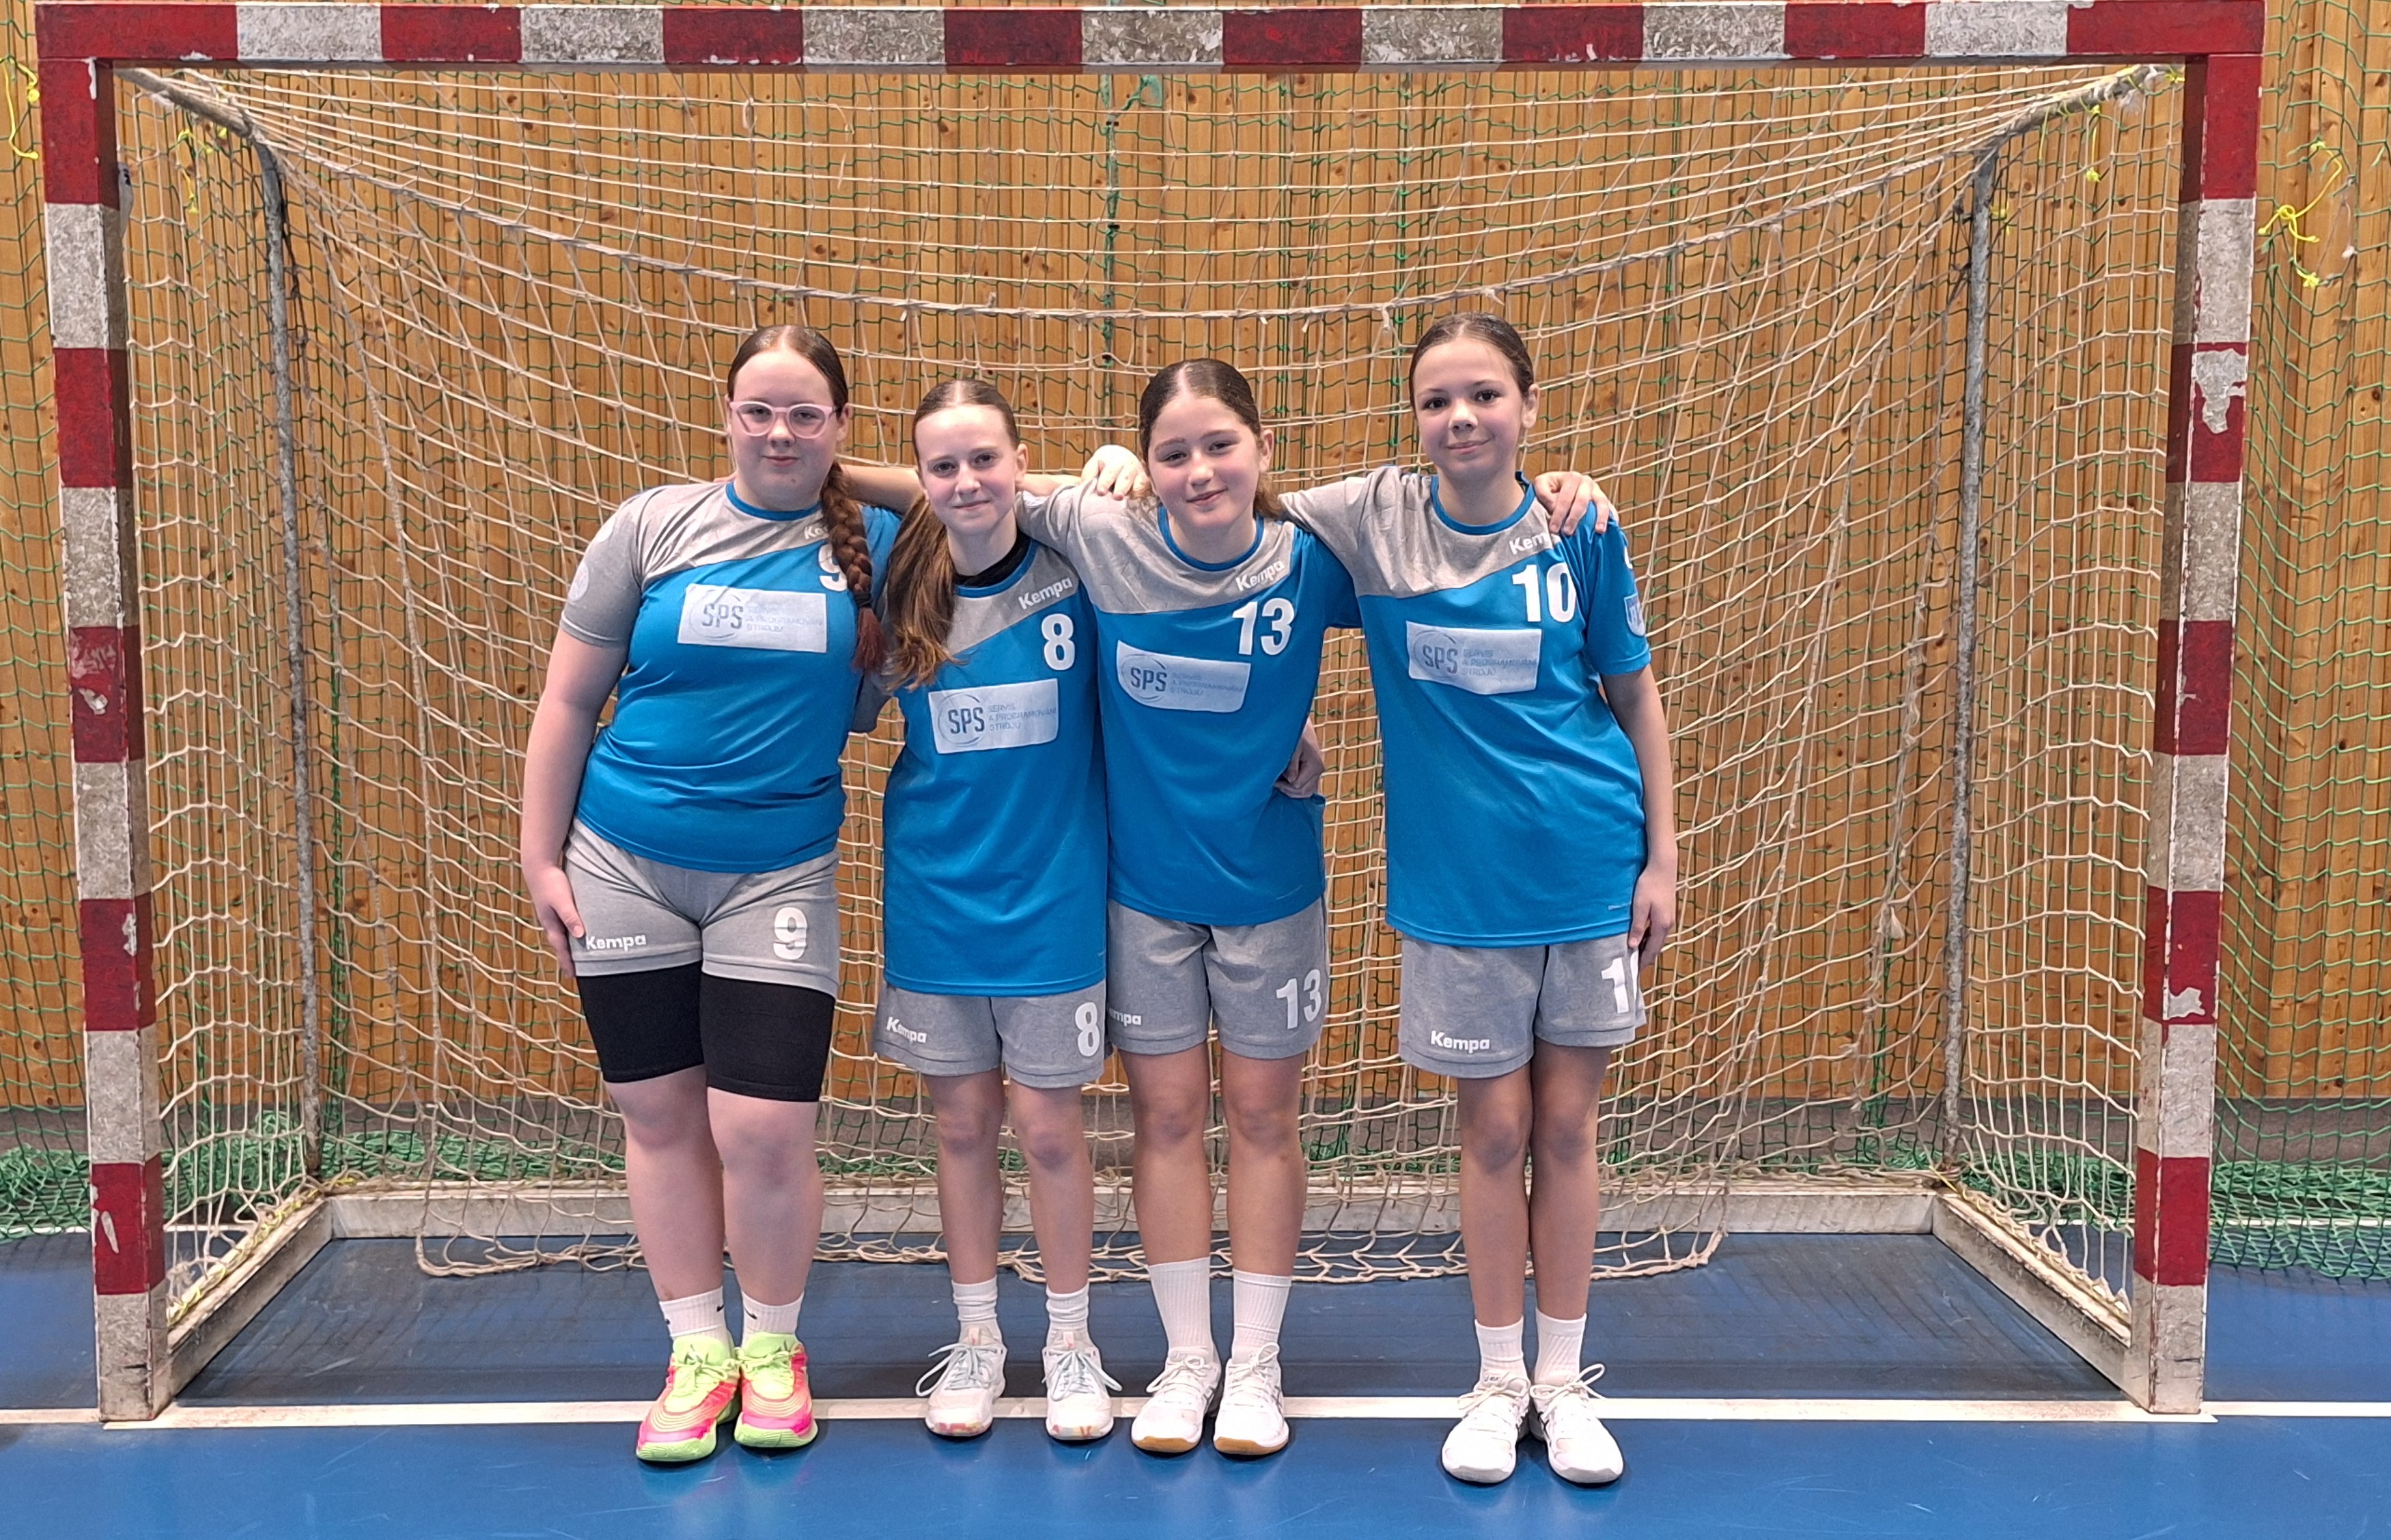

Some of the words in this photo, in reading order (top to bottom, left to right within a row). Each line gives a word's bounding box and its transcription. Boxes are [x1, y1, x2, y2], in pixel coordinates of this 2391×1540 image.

[1509, 533, 1548, 555] Kem
[818, 543, 848, 591] 9
[1235, 559, 1285, 592] Kempa
[1018, 577, 1073, 610] Kempa
[1511, 562, 1577, 623] 10
[701, 602, 744, 630] SPS
[1231, 598, 1295, 656] 13
[1041, 613, 1076, 671] 8
[1422, 644, 1459, 674] SPS
[1130, 667, 1168, 692] SPS
[947, 707, 985, 734] SPS
[585, 934, 647, 952] Kempa
[773, 907, 808, 960] 9
[1276, 968, 1322, 1030] 13
[886, 1016, 927, 1044] Kempa
[1074, 1002, 1100, 1057] 8
[1108, 1007, 1143, 1027] mpa
[1431, 1031, 1490, 1054] Kempa
